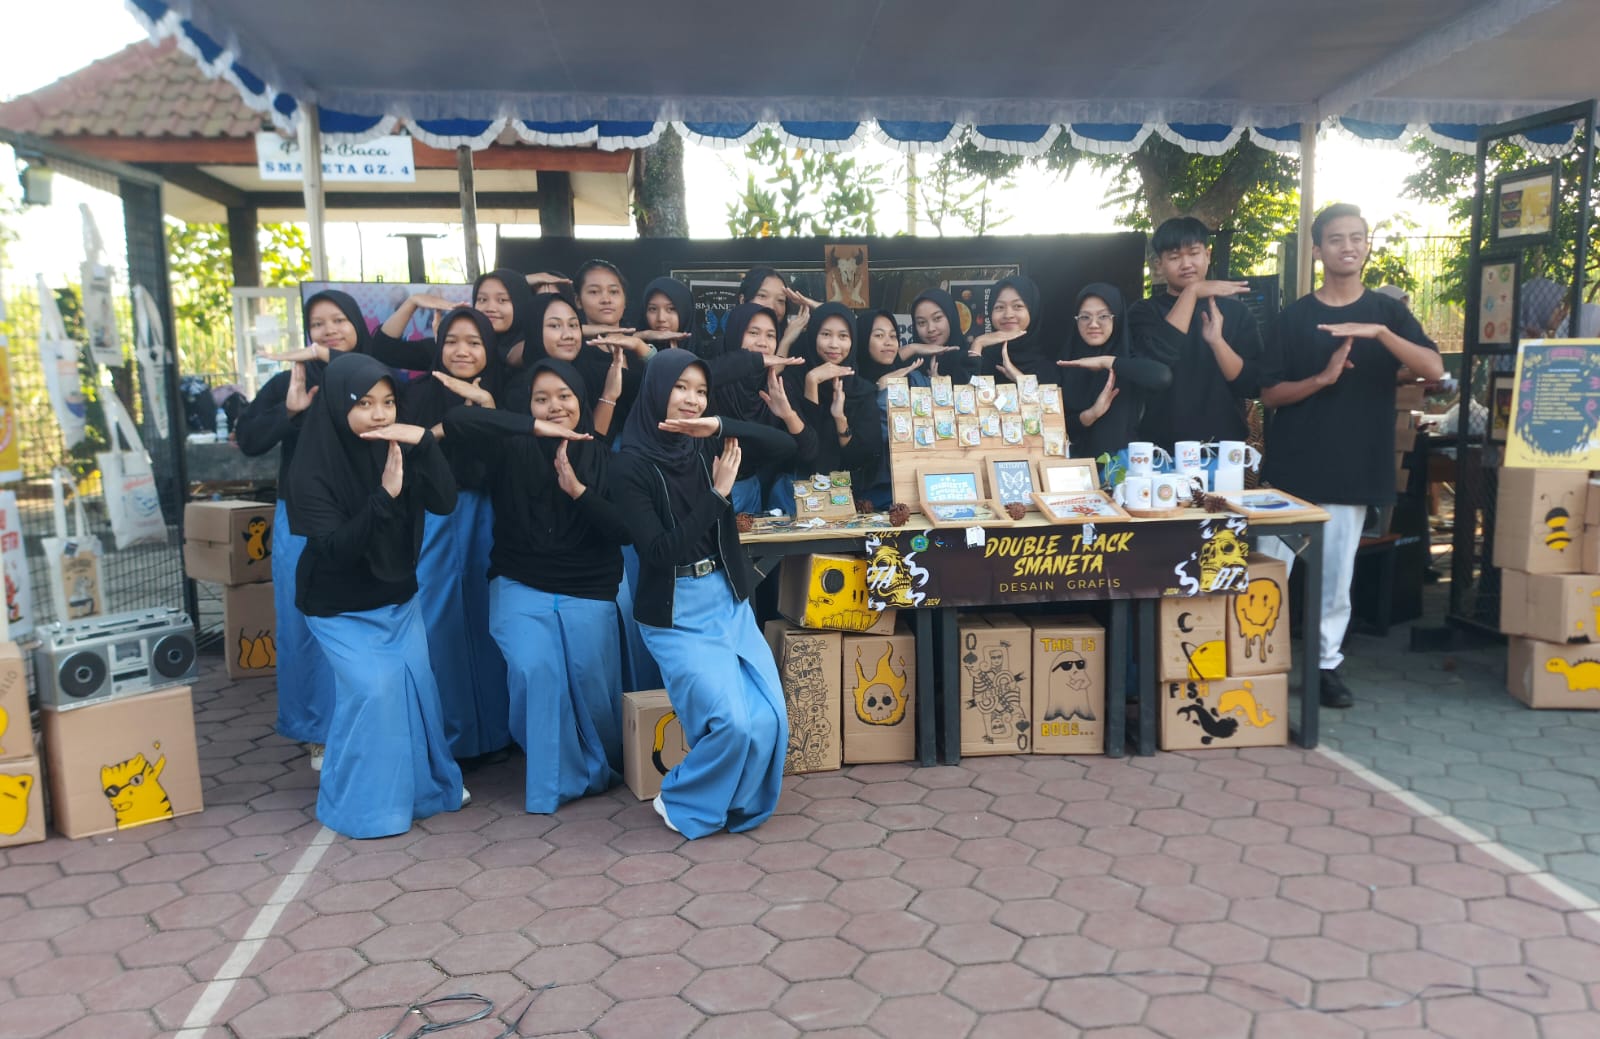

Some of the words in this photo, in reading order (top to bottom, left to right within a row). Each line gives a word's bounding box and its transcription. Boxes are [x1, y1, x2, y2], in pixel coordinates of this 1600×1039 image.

[265, 161, 357, 175] SMAETA
[401, 165, 410, 175] 4
[984, 534, 1062, 558] DOUBLE
[1013, 554, 1104, 577] SMANETA
[1000, 581, 1054, 593] DESAIN
[1067, 578, 1121, 590] GRAFIS
[1040, 637, 1074, 652] THIS
[1081, 637, 1097, 652] IS
[1169, 682, 1211, 700] FISH
